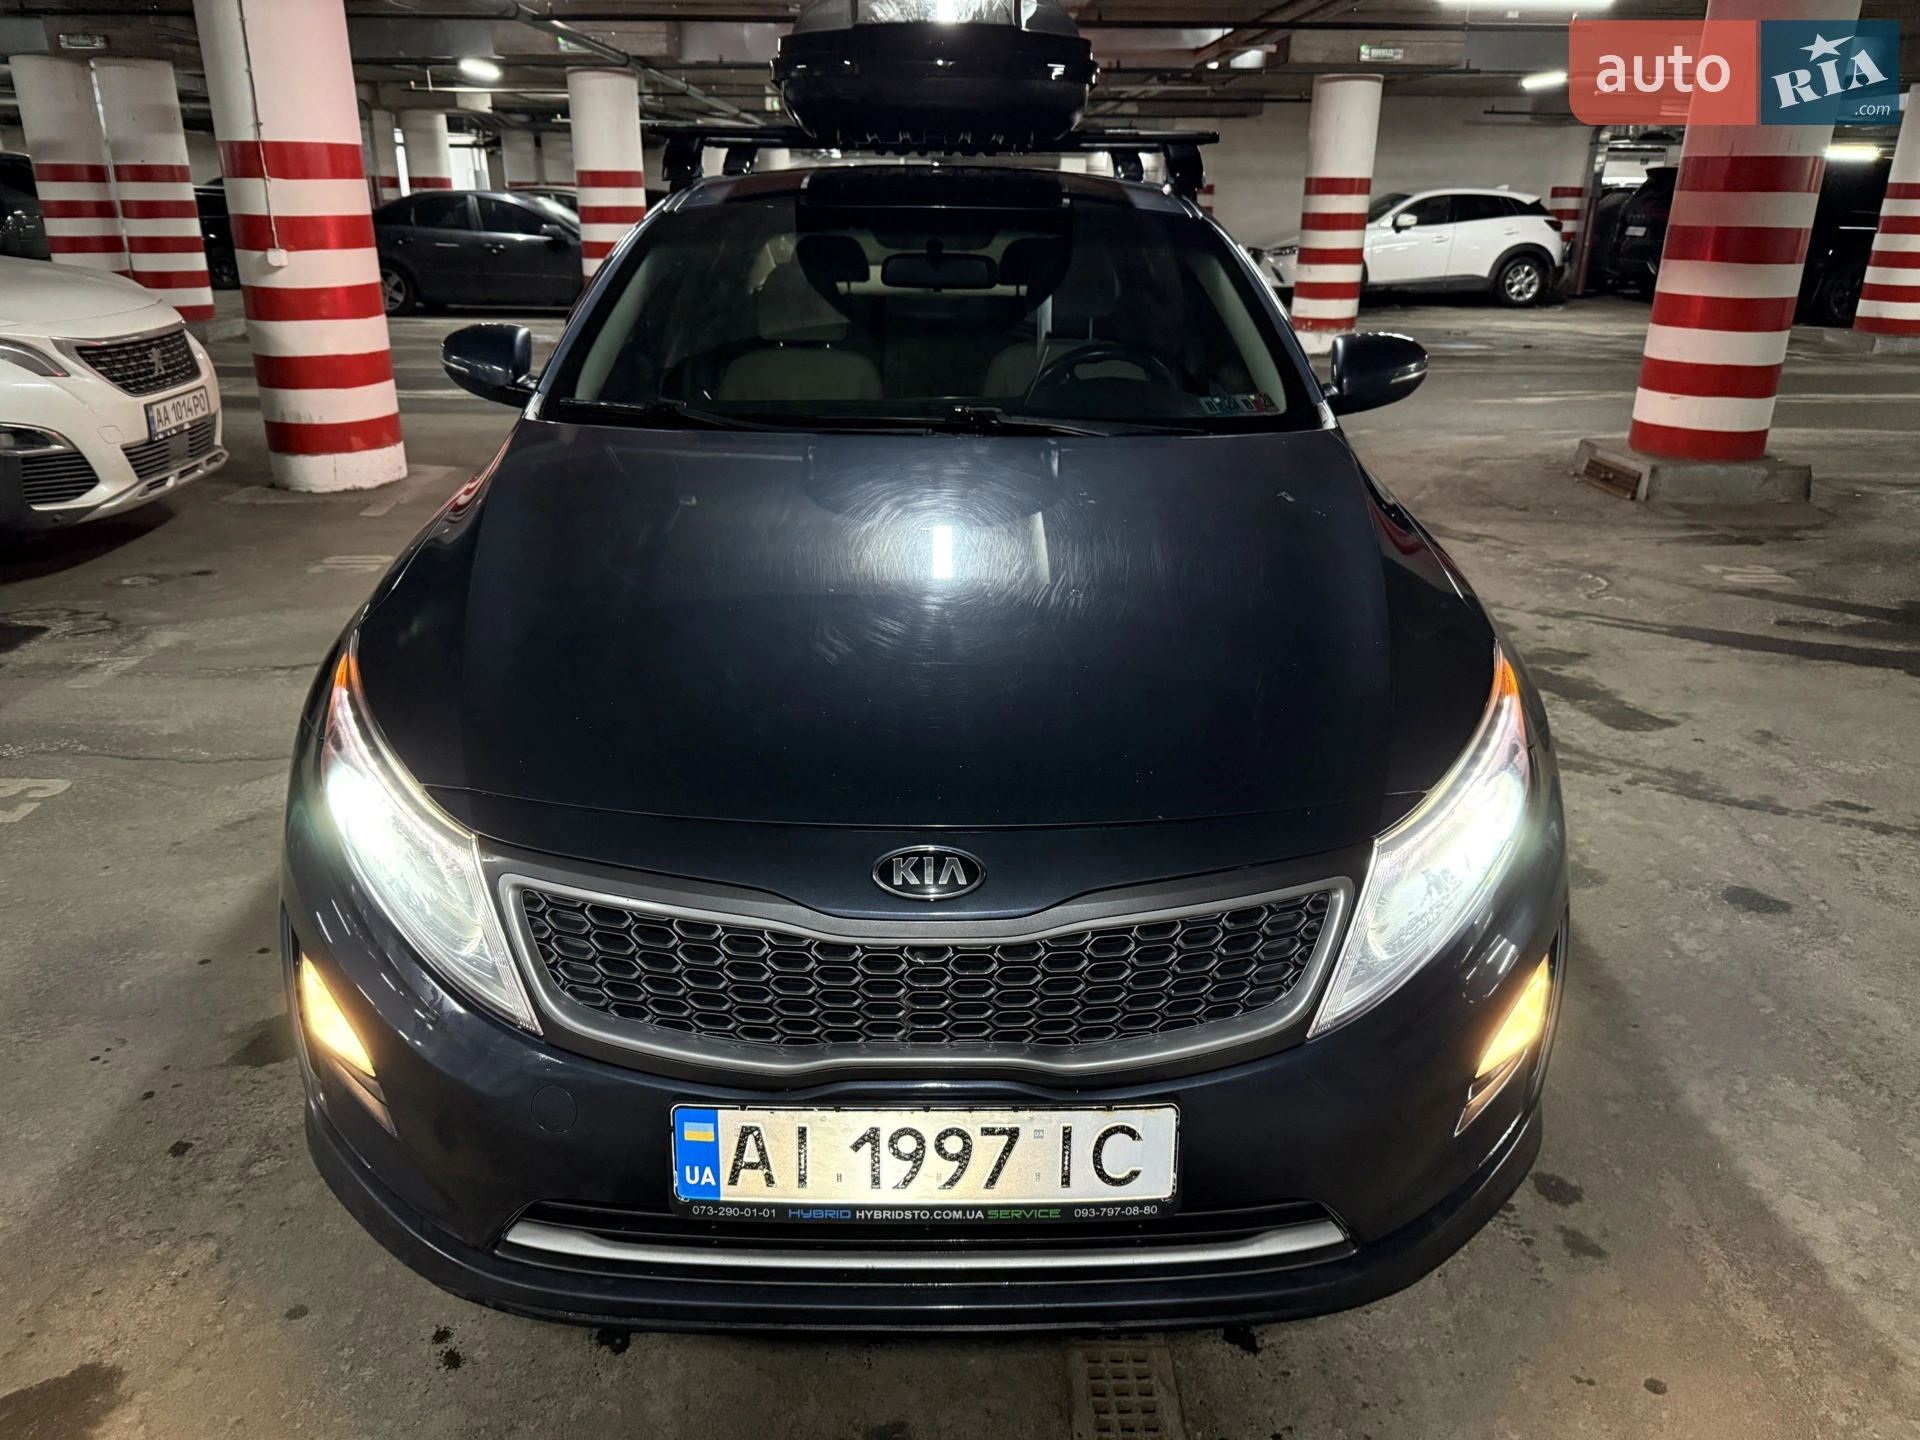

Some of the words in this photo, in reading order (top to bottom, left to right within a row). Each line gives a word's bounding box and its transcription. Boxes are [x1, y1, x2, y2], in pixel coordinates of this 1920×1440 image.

[156, 405, 171, 429] AA
[171, 396, 193, 422] 1014
[892, 856, 967, 885] KIA
[727, 1125, 808, 1189] AI
[849, 1126, 1020, 1190] 1997
[1060, 1124, 1143, 1188] IC
[685, 1165, 716, 1186] UA
[692, 1205, 776, 1218] 073-290-01-01
[788, 1209, 851, 1219] HYBRID
[856, 1210, 984, 1219] HYBRIDSTO.COM.UA
[987, 1209, 1061, 1219] SERVICE
[1074, 1205, 1158, 1218] 093-797-08-80
